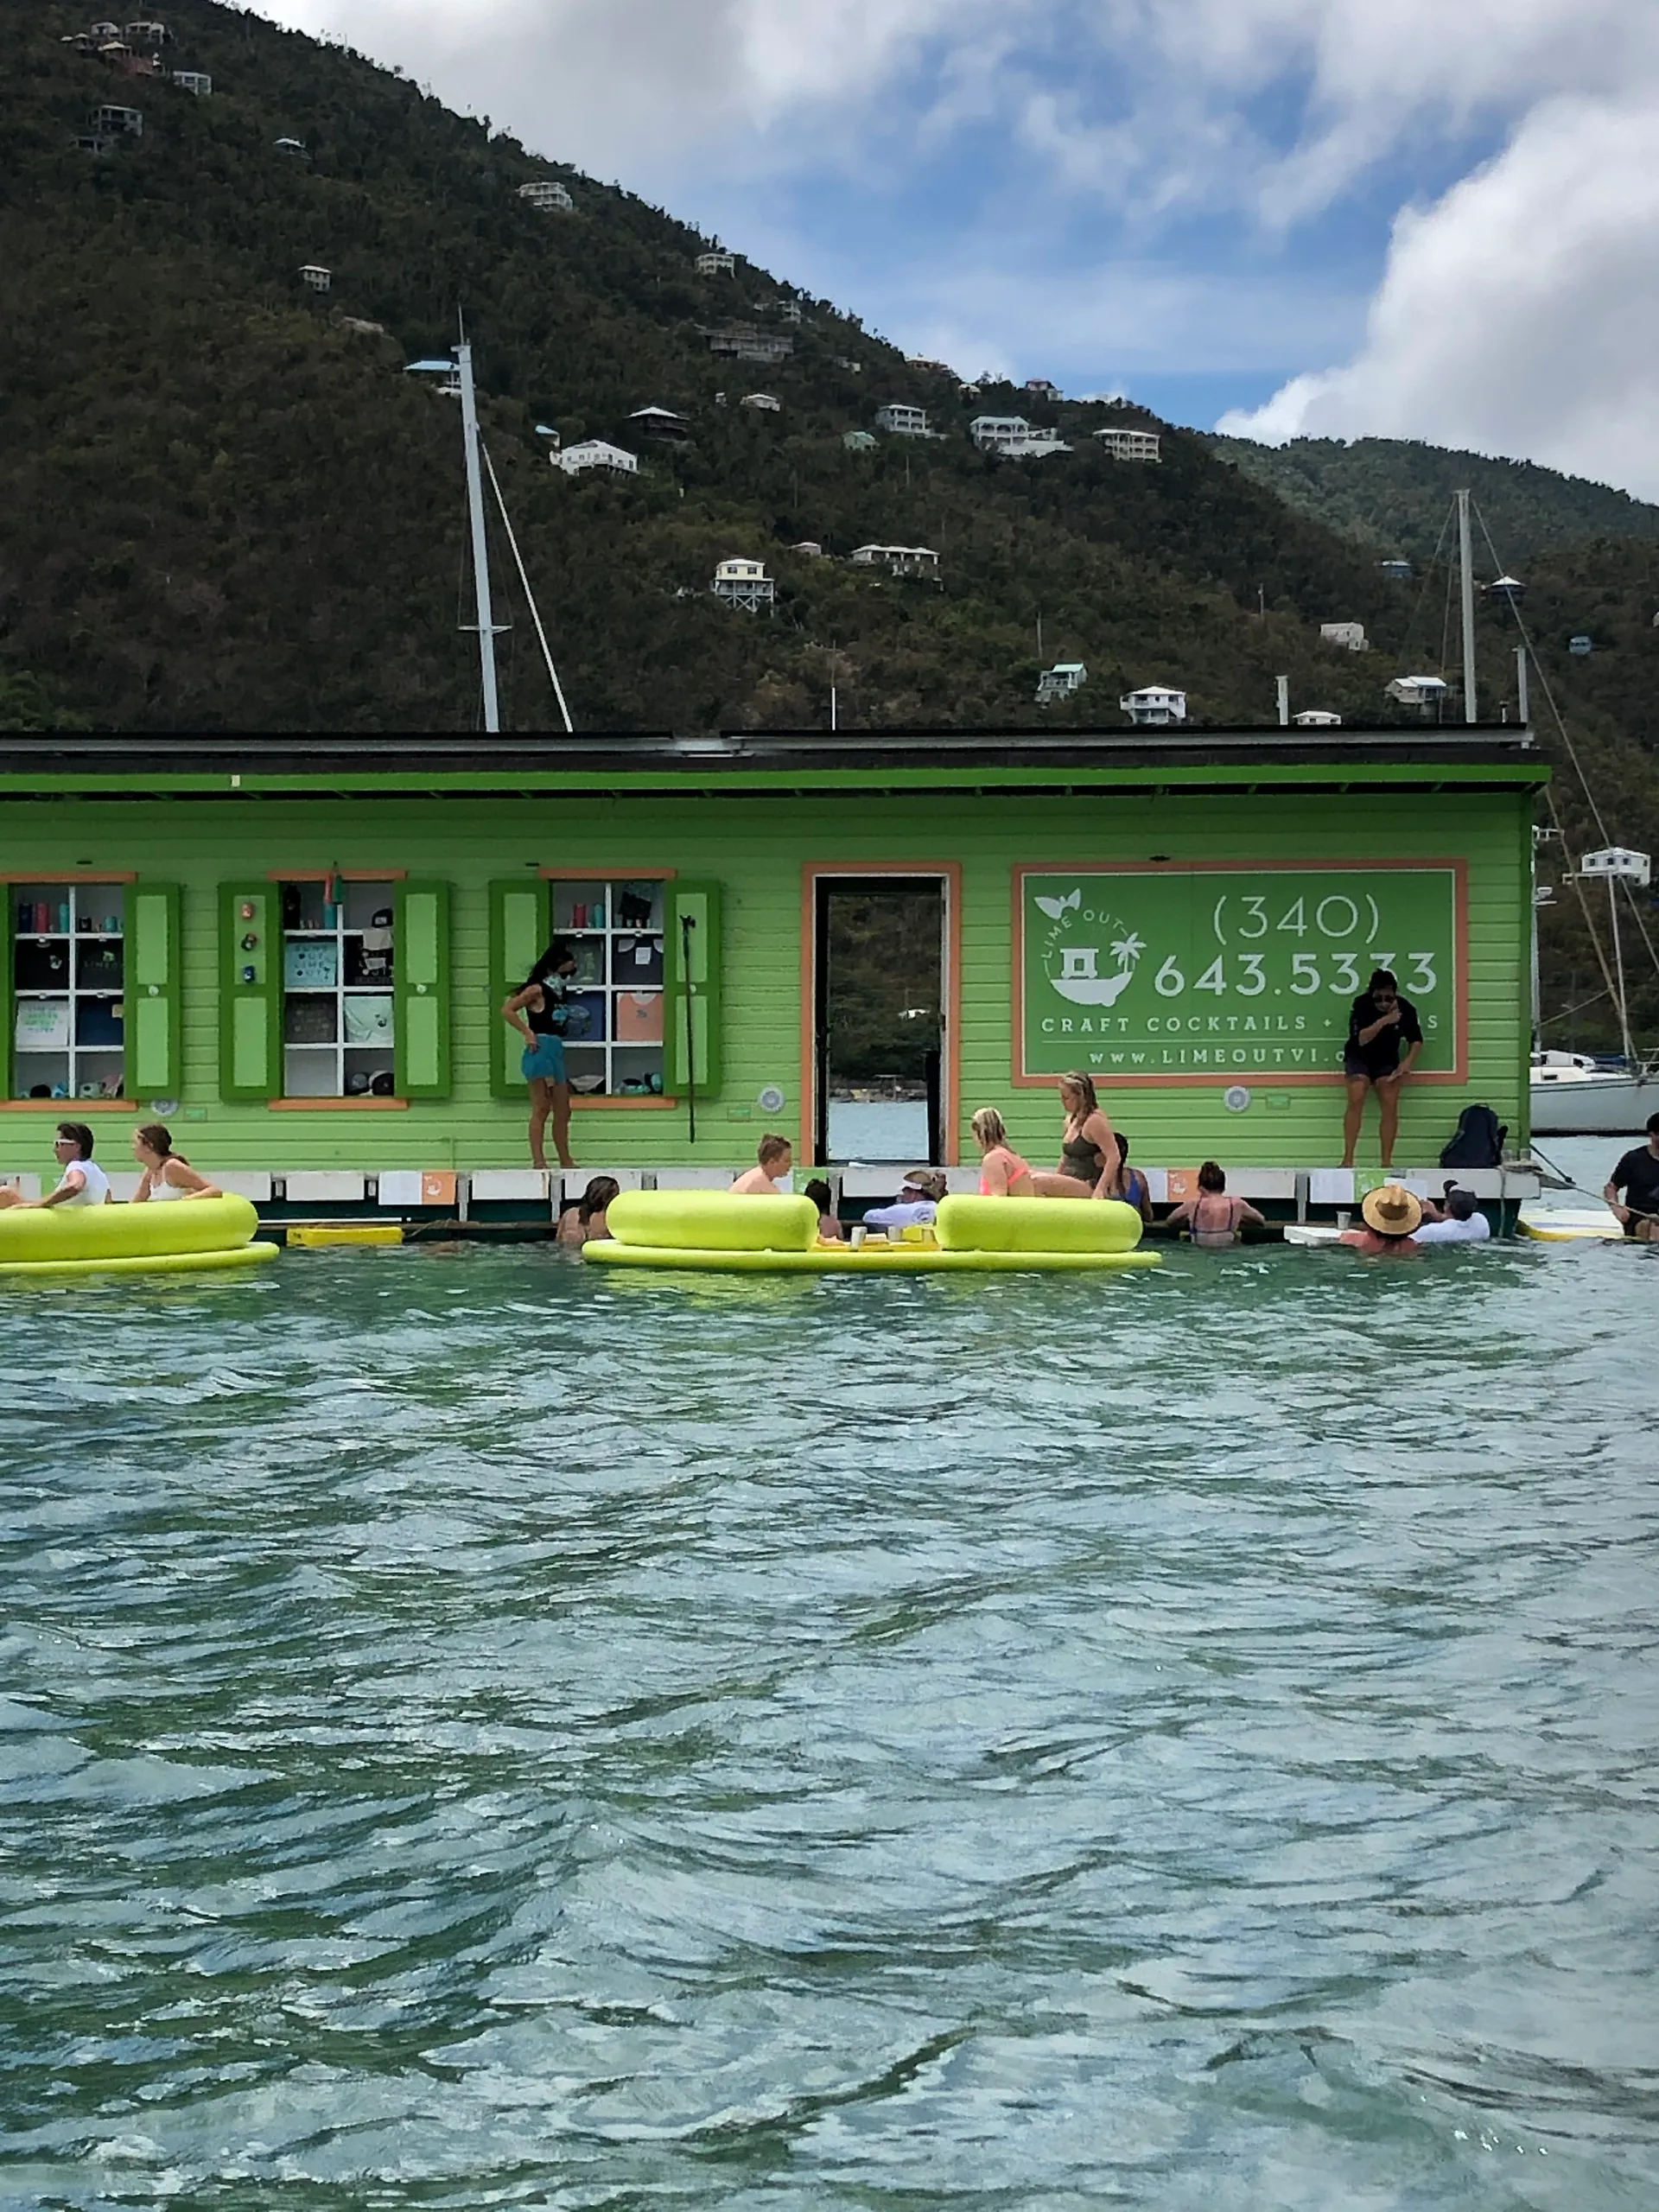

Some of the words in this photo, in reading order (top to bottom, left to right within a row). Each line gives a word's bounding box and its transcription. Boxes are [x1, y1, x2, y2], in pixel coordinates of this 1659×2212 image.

[1040, 916, 1072, 959] LIME
[1083, 909, 1123, 930] OUT
[1214, 894, 1379, 945] (340)
[1041, 1017, 1129, 1033] CRAFT
[1147, 1015, 1306, 1032] COCKTAILS
